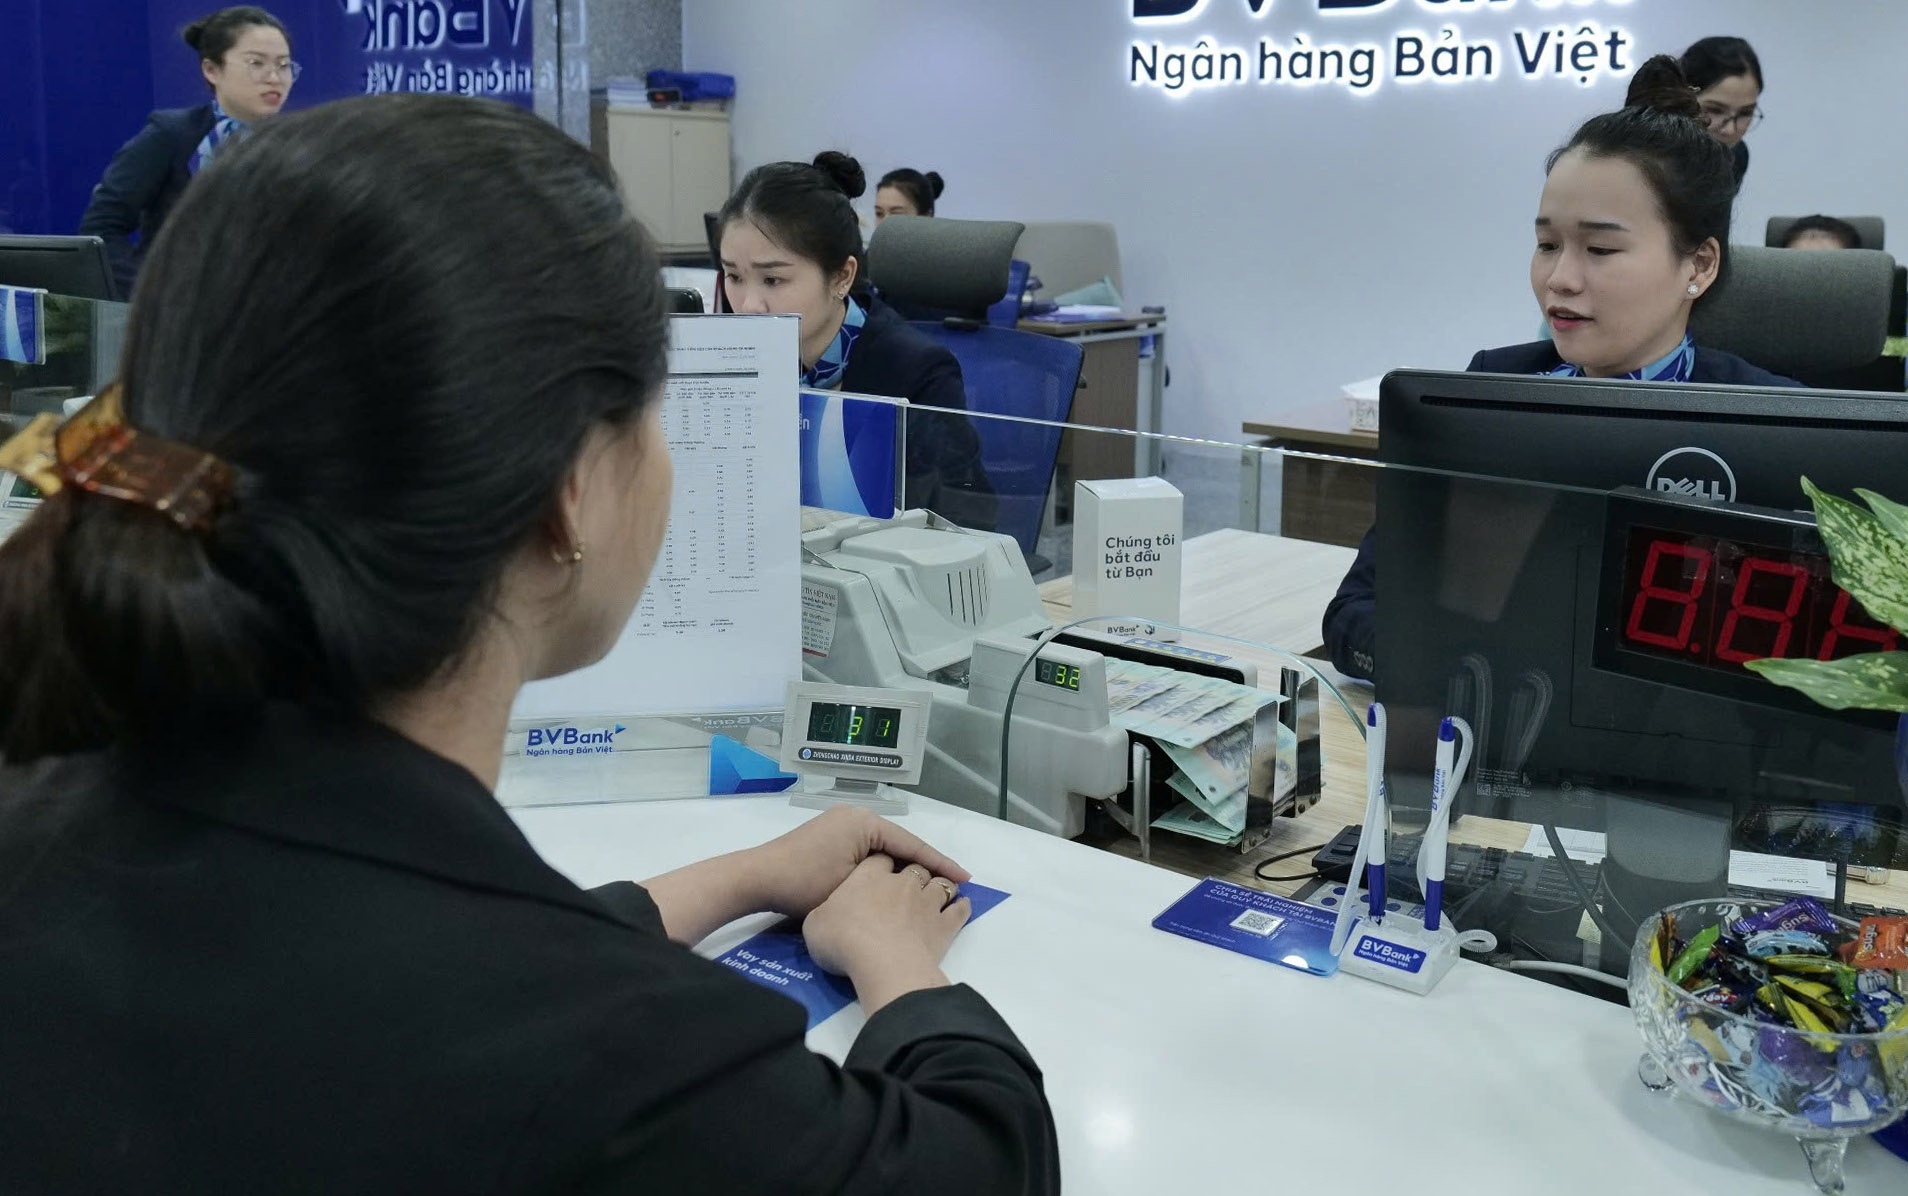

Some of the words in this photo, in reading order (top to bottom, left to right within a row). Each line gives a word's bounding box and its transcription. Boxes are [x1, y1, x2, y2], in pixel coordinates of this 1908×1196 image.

[1131, 40, 1242, 89] Ngân
[1259, 37, 1376, 88] hàng
[1395, 29, 1493, 77] Bản
[1514, 26, 1627, 84] Việt
[1657, 477, 1726, 501] DELL
[1105, 536, 1152, 550] Chúng
[1156, 534, 1175, 546] tôi
[1105, 549, 1130, 564] bắt
[1134, 549, 1160, 562] đầu
[1105, 567, 1122, 579] từ
[1126, 566, 1153, 580] Bạn
[1107, 626, 1136, 634] BVBank
[1055, 664, 1080, 688] 32
[527, 727, 614, 746] BVBank
[526, 747, 549, 757] Ngân
[552, 746, 574, 755] hàng
[576, 746, 593, 754] Bản
[595, 745, 613, 754] Việt
[855, 754, 879, 764] EXTERIOR
[879, 757, 900, 765] DISPLAY
[1215, 885, 1237, 893] CHIA
[1304, 914, 1336, 927] BVBAN
[1360, 939, 1412, 962] BVBank
[721, 957, 750, 971] kinh
[749, 967, 790, 986] doanh
[736, 949, 760, 962] Vay
[758, 959, 783, 971] sản
[782, 966, 814, 981] xuất
